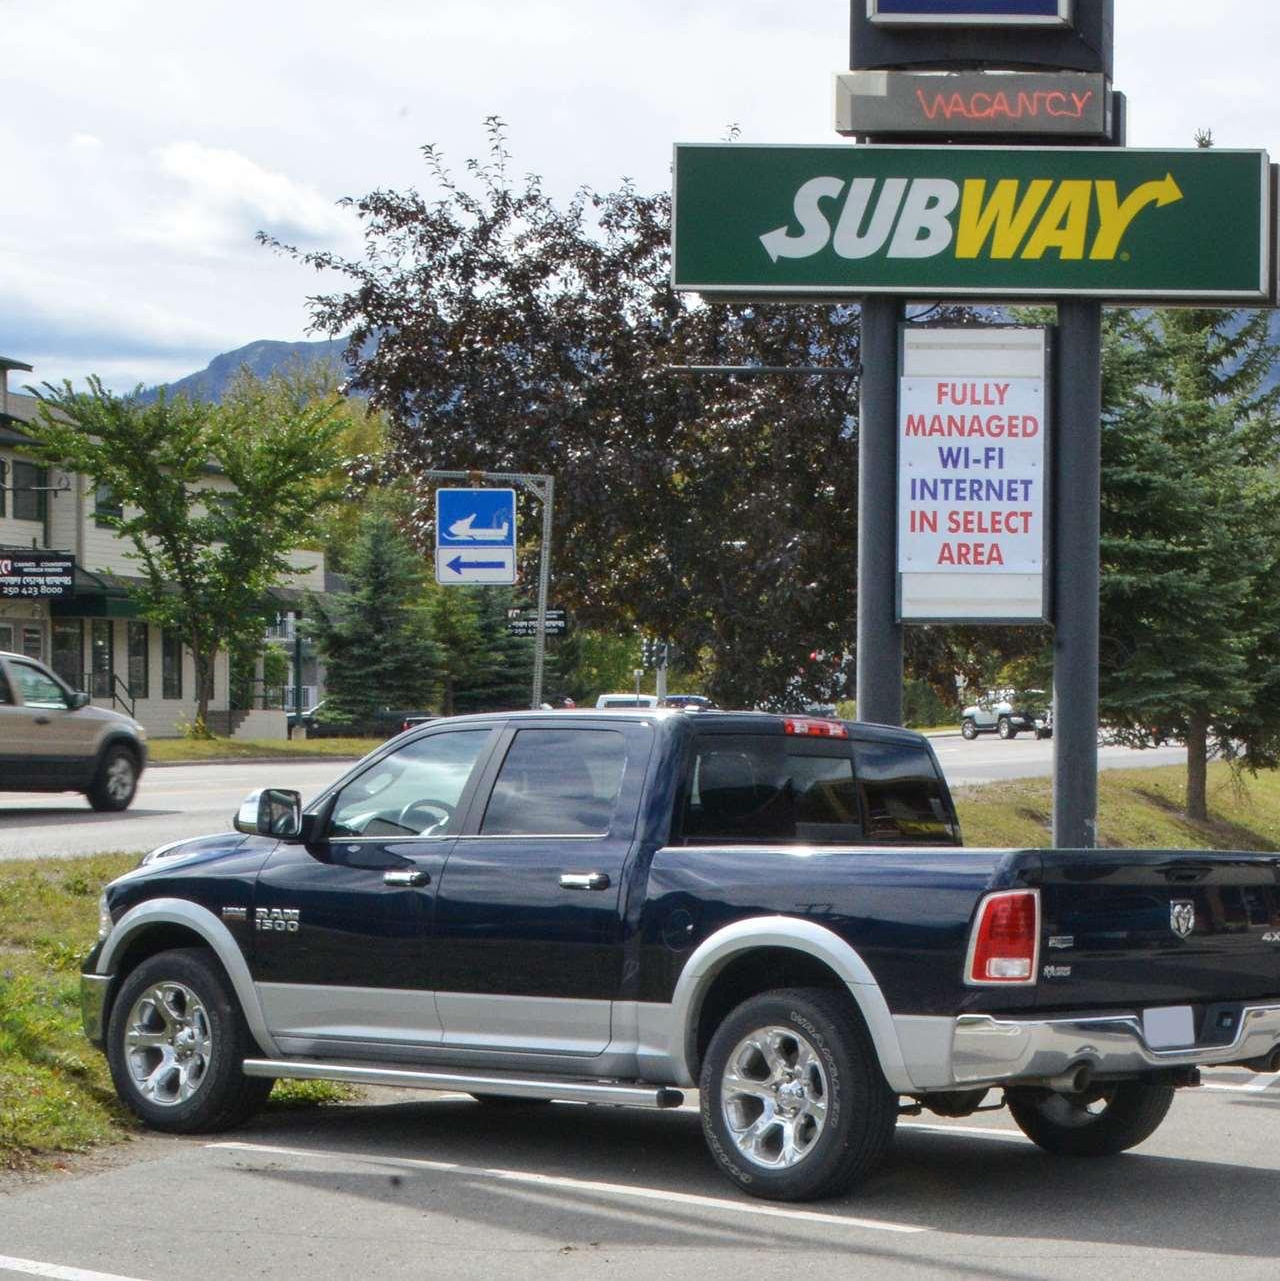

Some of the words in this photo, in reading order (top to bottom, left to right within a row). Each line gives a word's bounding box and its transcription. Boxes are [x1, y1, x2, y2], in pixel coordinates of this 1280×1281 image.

[915, 88, 1093, 120] VACANCY
[758, 172, 1184, 263] SUBWAY
[936, 382, 1010, 406] FULLY
[905, 414, 1039, 438] MANAGED
[937, 446, 1005, 469] WI-FI
[910, 478, 1033, 501] INTERNET
[910, 510, 938, 533] IN
[948, 510, 1033, 533] SELECT
[937, 542, 1004, 565] AREA
[2, 586, 20, 596] 250
[21, 586, 39, 596] 423
[40, 585, 63, 594] 8000
[255, 907, 300, 920] RAM
[255, 919, 300, 932] 1500
